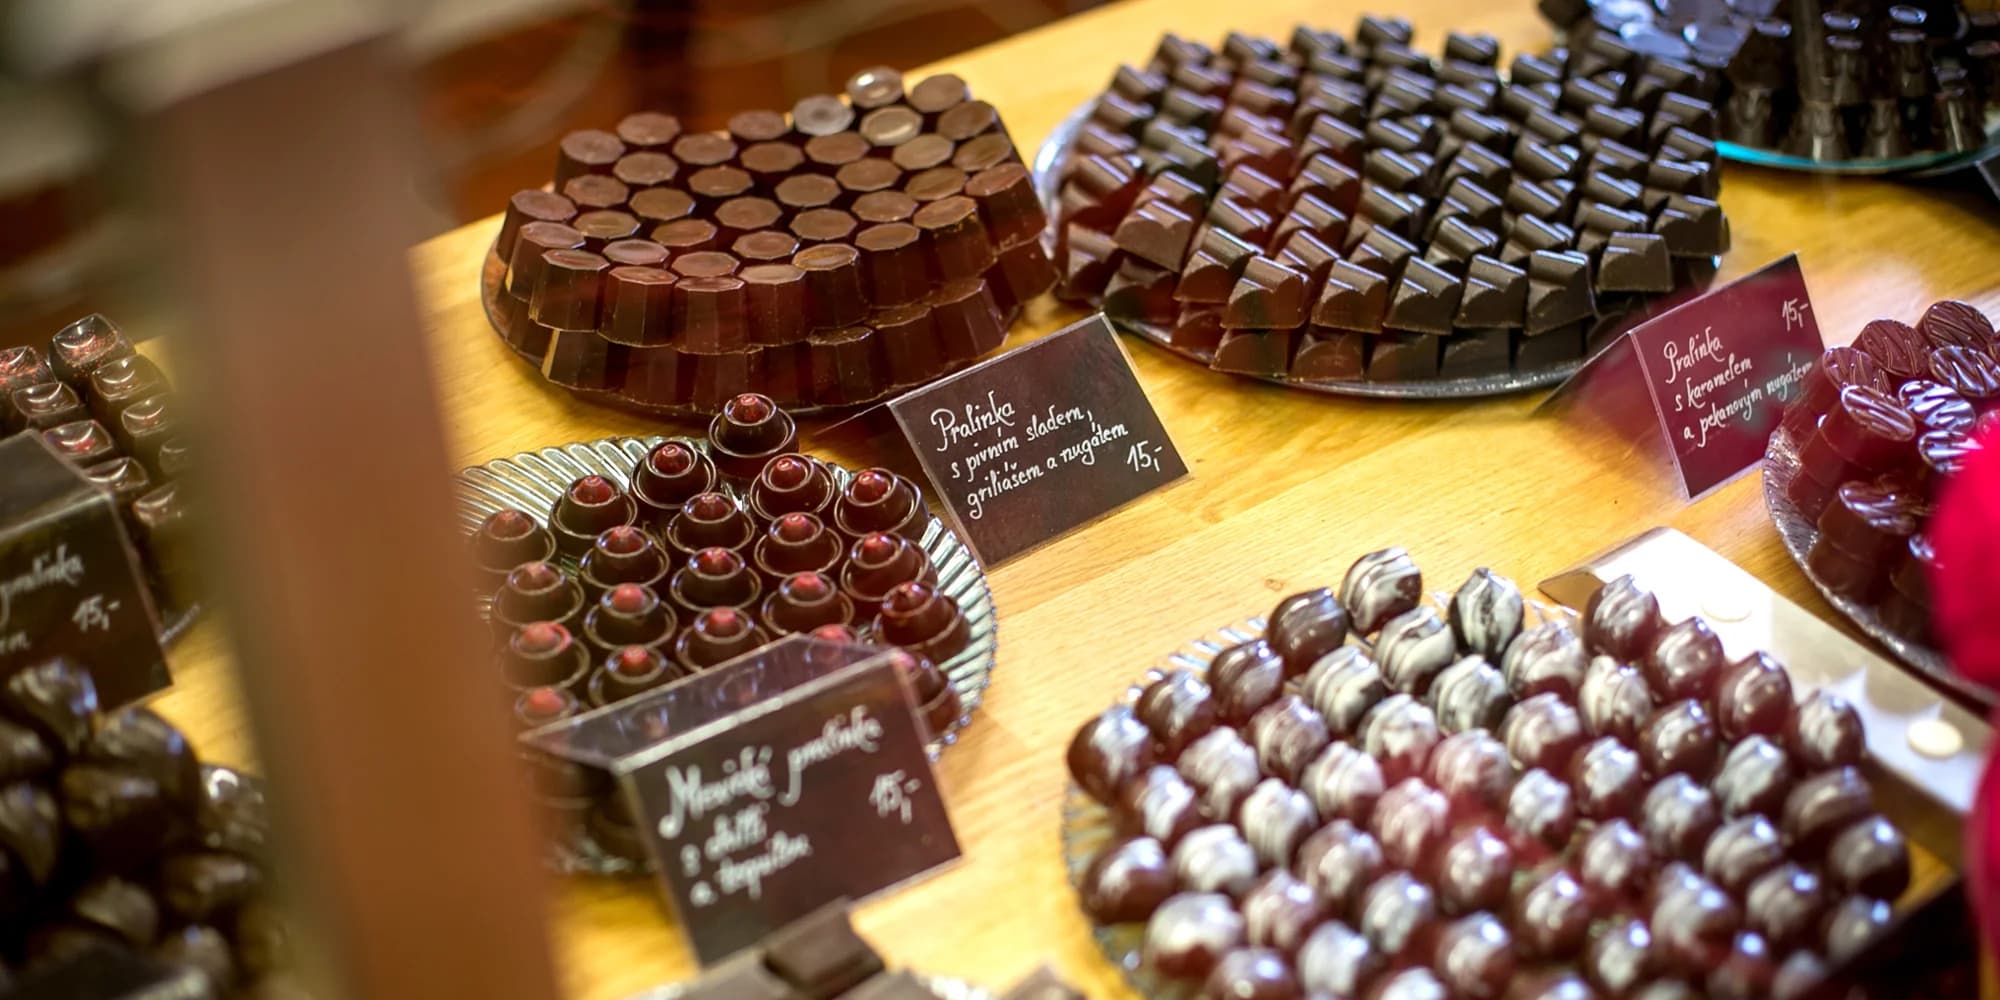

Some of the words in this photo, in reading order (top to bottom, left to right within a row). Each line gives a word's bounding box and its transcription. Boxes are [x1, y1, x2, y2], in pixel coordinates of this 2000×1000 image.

[1782, 298, 1809, 332] 15,-
[1664, 326, 1725, 384] Pralinka
[1675, 393, 1683, 412] s
[1687, 353, 1752, 409] karamelem
[931, 390, 1016, 452] Pralinka
[1684, 426, 1694, 440] a
[1697, 379, 1762, 447] pekanovým
[951, 462, 960, 479] s
[966, 427, 1019, 482] pivním
[1026, 405, 1093, 442] sladem,
[967, 461, 1044, 520] griliášem
[1047, 456, 1058, 470] a
[1060, 421, 1129, 466] nugátem
[1126, 440, 1163, 472] 15,-
[72, 593, 121, 632] 15,-
[777, 705, 884, 805] pralinka
[869, 769, 921, 824] 15,-
